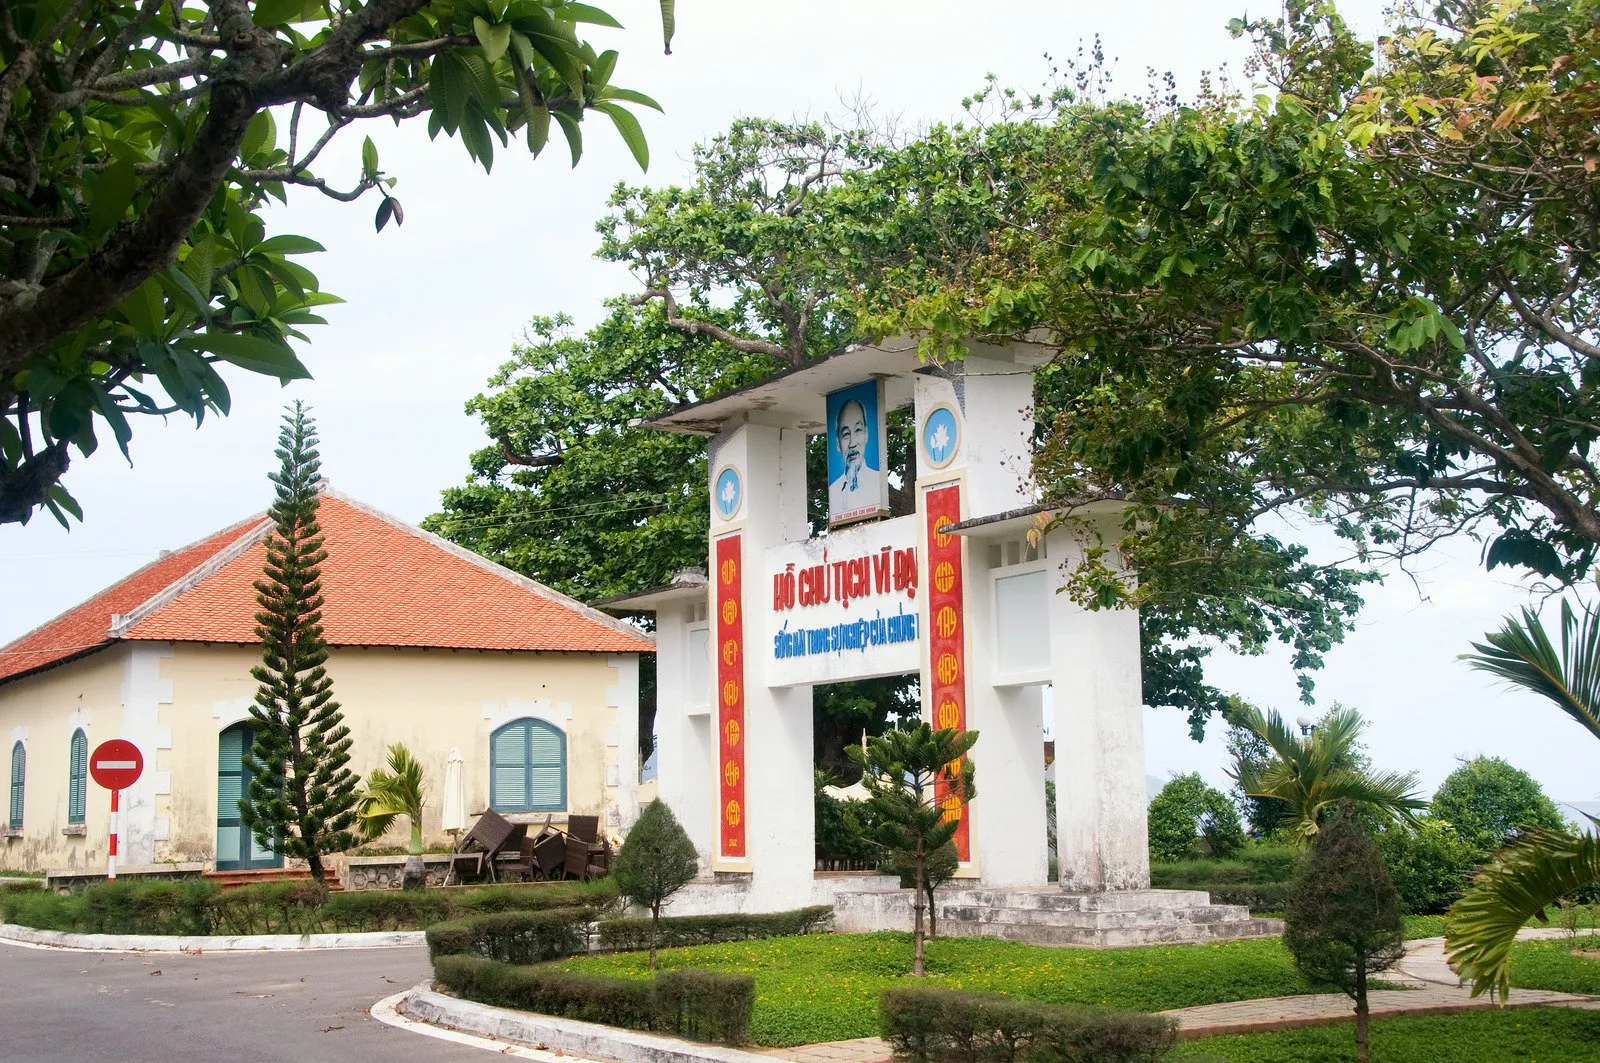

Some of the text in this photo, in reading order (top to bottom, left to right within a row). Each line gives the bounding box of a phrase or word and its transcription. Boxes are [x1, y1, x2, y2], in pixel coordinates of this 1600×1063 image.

[798, 546, 831, 607] CHỦ
[832, 556, 870, 609] TỊCH
[872, 545, 891, 595] VĨ
[774, 619, 793, 659] SỐNG
[792, 628, 806, 657] MÃI
[806, 627, 831, 655] TRONG
[841, 617, 870, 653] NGHIỆP
[869, 608, 887, 646] CỦA
[887, 601, 915, 644] CHÚNG
